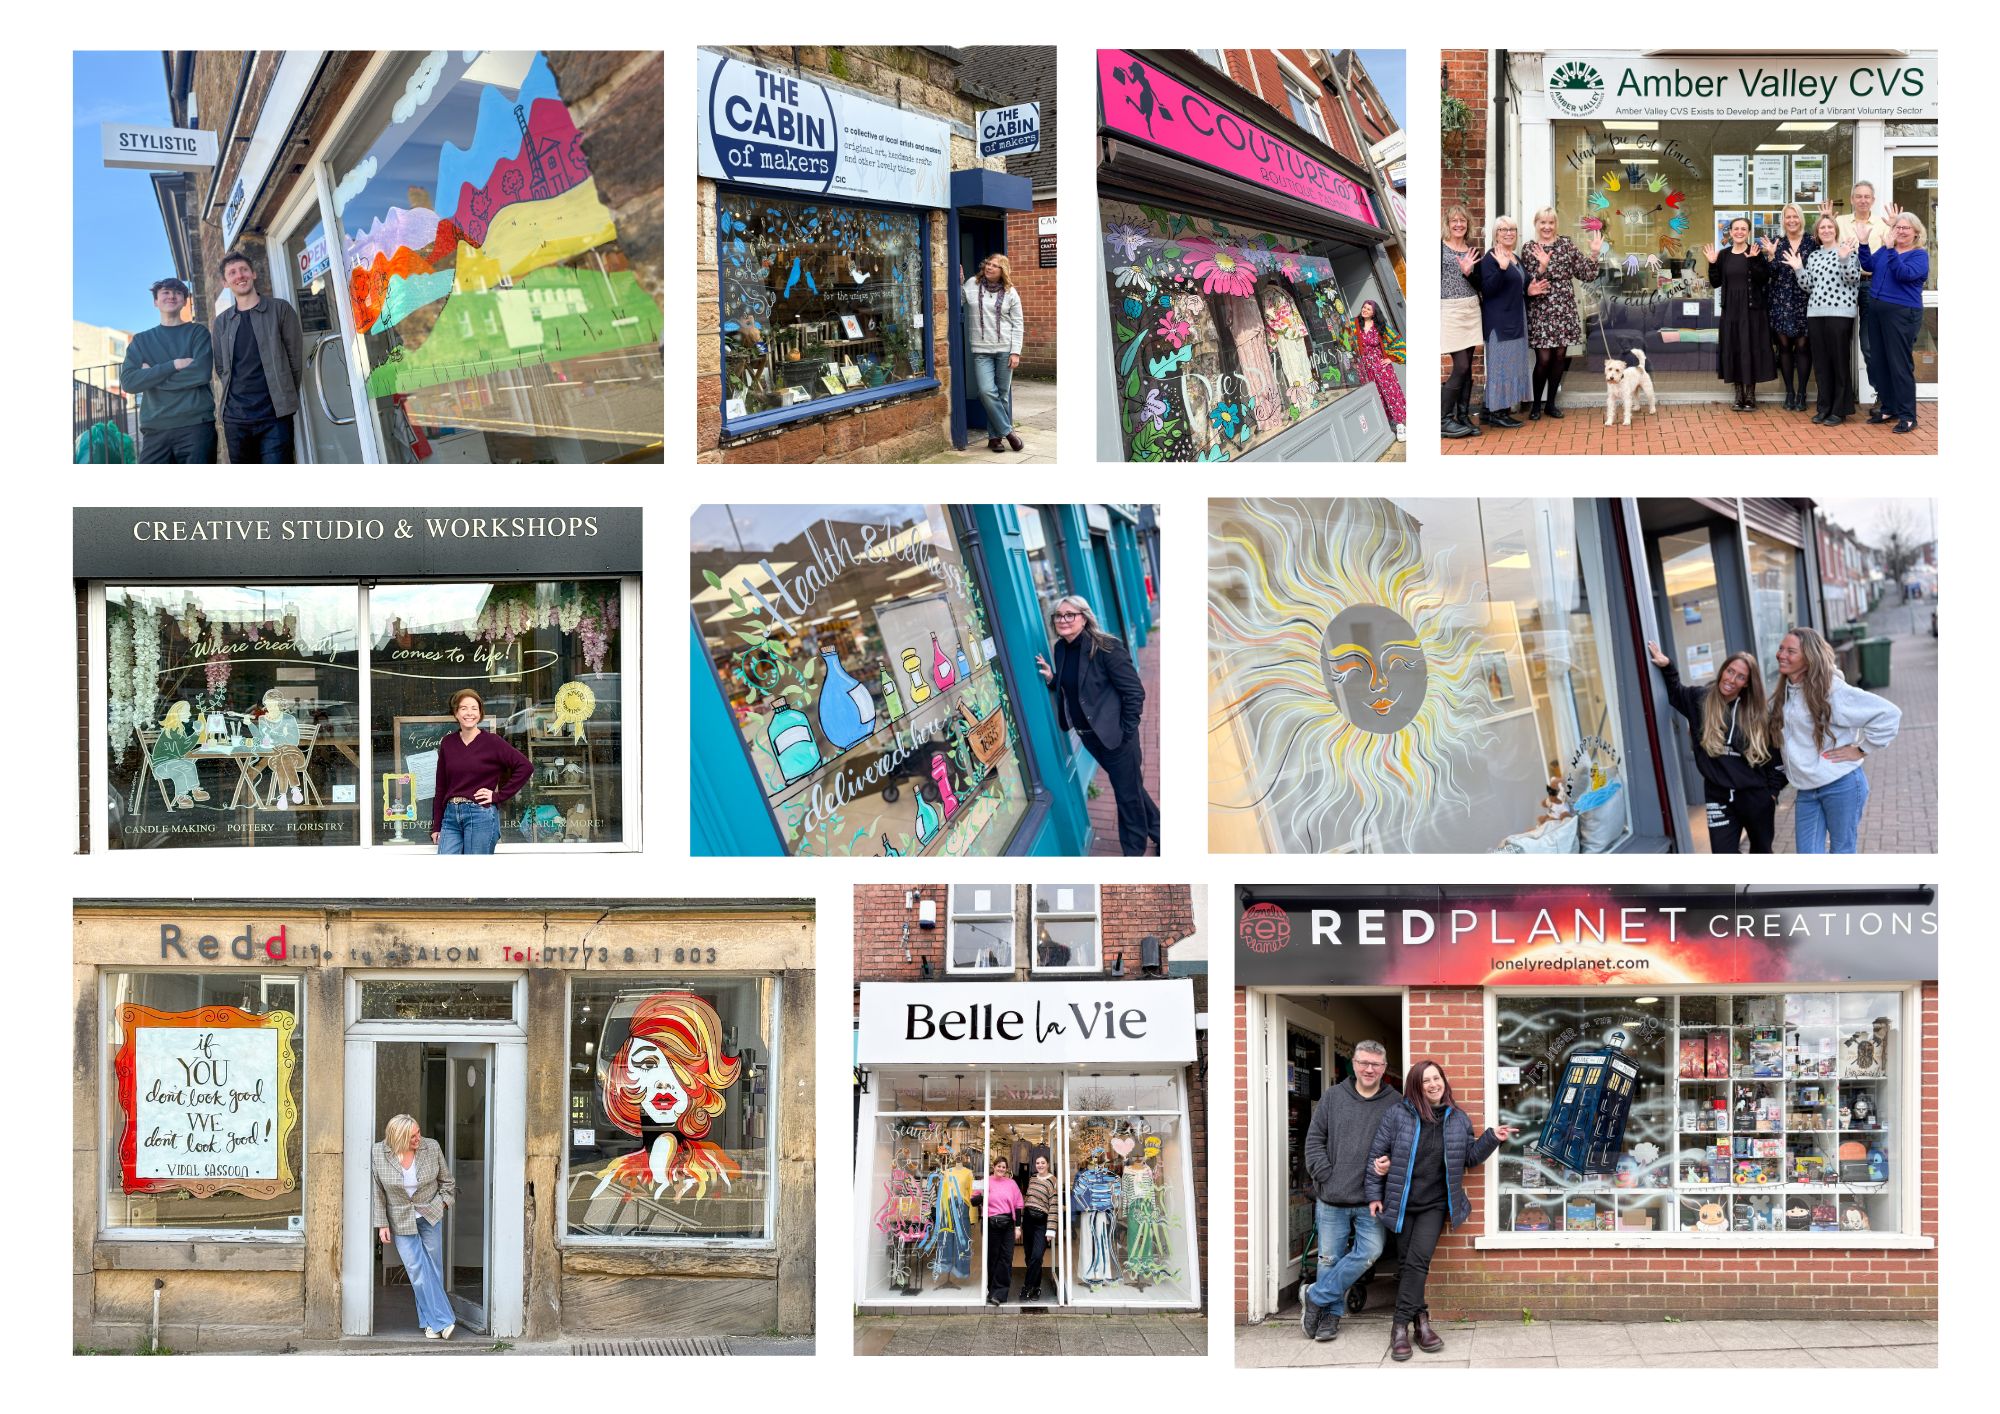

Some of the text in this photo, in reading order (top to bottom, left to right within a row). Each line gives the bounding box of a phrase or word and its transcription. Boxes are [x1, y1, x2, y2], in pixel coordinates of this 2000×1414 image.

[756, 70, 798, 106] THE
[1617, 68, 1924, 104] Amber Valley CVS
[1554, 91, 1600, 112] AMBER VALLEY
[1616, 106, 1642, 115] Amber
[1644, 106, 1668, 116] Valley
[1670, 107, 1688, 115] CVS
[1691, 107, 1714, 115] Exists
[1726, 107, 1759, 116] Develop
[1761, 107, 1776, 115] and
[1778, 106, 1788, 115] be
[1790, 107, 1807, 115] Part
[1810, 106, 1818, 115] of
[1826, 106, 1854, 115] Vibrant
[1857, 106, 1894, 116] Voluntary
[1896, 106, 1922, 115] Sector
[725, 94, 825, 150] CABIN
[996, 108, 1018, 122] THE
[120, 132, 196, 152] STYLISTIC
[850, 128, 878, 140] collective
[885, 135, 898, 144] local
[900, 140, 914, 149] artists
[915, 143, 924, 151] and
[984, 118, 1034, 140] CABIN
[844, 142, 874, 154] original
[984, 133, 1037, 154] of makers
[1566, 143, 1600, 170] Have
[1603, 132, 1629, 155] You
[1636, 133, 1659, 153] Got
[728, 144, 829, 174] of makers
[844, 155, 916, 176] and other lovely things
[835, 176, 846, 184] CIC
[1260, 168, 1316, 199] BOUTIQUE
[838, 290, 848, 300] the
[133, 516, 598, 542] CREATIVE STUDIO & WORKSHOPS
[742, 518, 862, 638] Health
[860, 524, 884, 564] &
[190, 638, 248, 659] Where
[392, 648, 443, 661] comes
[446, 646, 466, 663] to
[473, 642, 512, 672] life!
[1572, 736, 1592, 769] HAPPY
[804, 732, 911, 832] delivered
[125, 822, 344, 834] CANDLE MAKING POTTERY FLORISTRY
[382, 822, 416, 830] FUED
[570, 819, 604, 828] MORE!
[1708, 912, 1938, 938] CREATIONS
[160, 924, 286, 960] Redd
[674, 946, 716, 963] 803
[1491, 957, 1649, 972] lonelyredplanet.com
[904, 1000, 1147, 1044] Belle la Vie
[192, 1033, 220, 1060] if
[1544, 1027, 1578, 1061] BIGGER
[177, 1057, 230, 1088] YOU
[146, 1078, 266, 1114] don't look good
[186, 1112, 224, 1132] WE
[144, 1126, 182, 1149] don't
[183, 1134, 222, 1156] look
[166, 1164, 200, 1177] VIDAL
